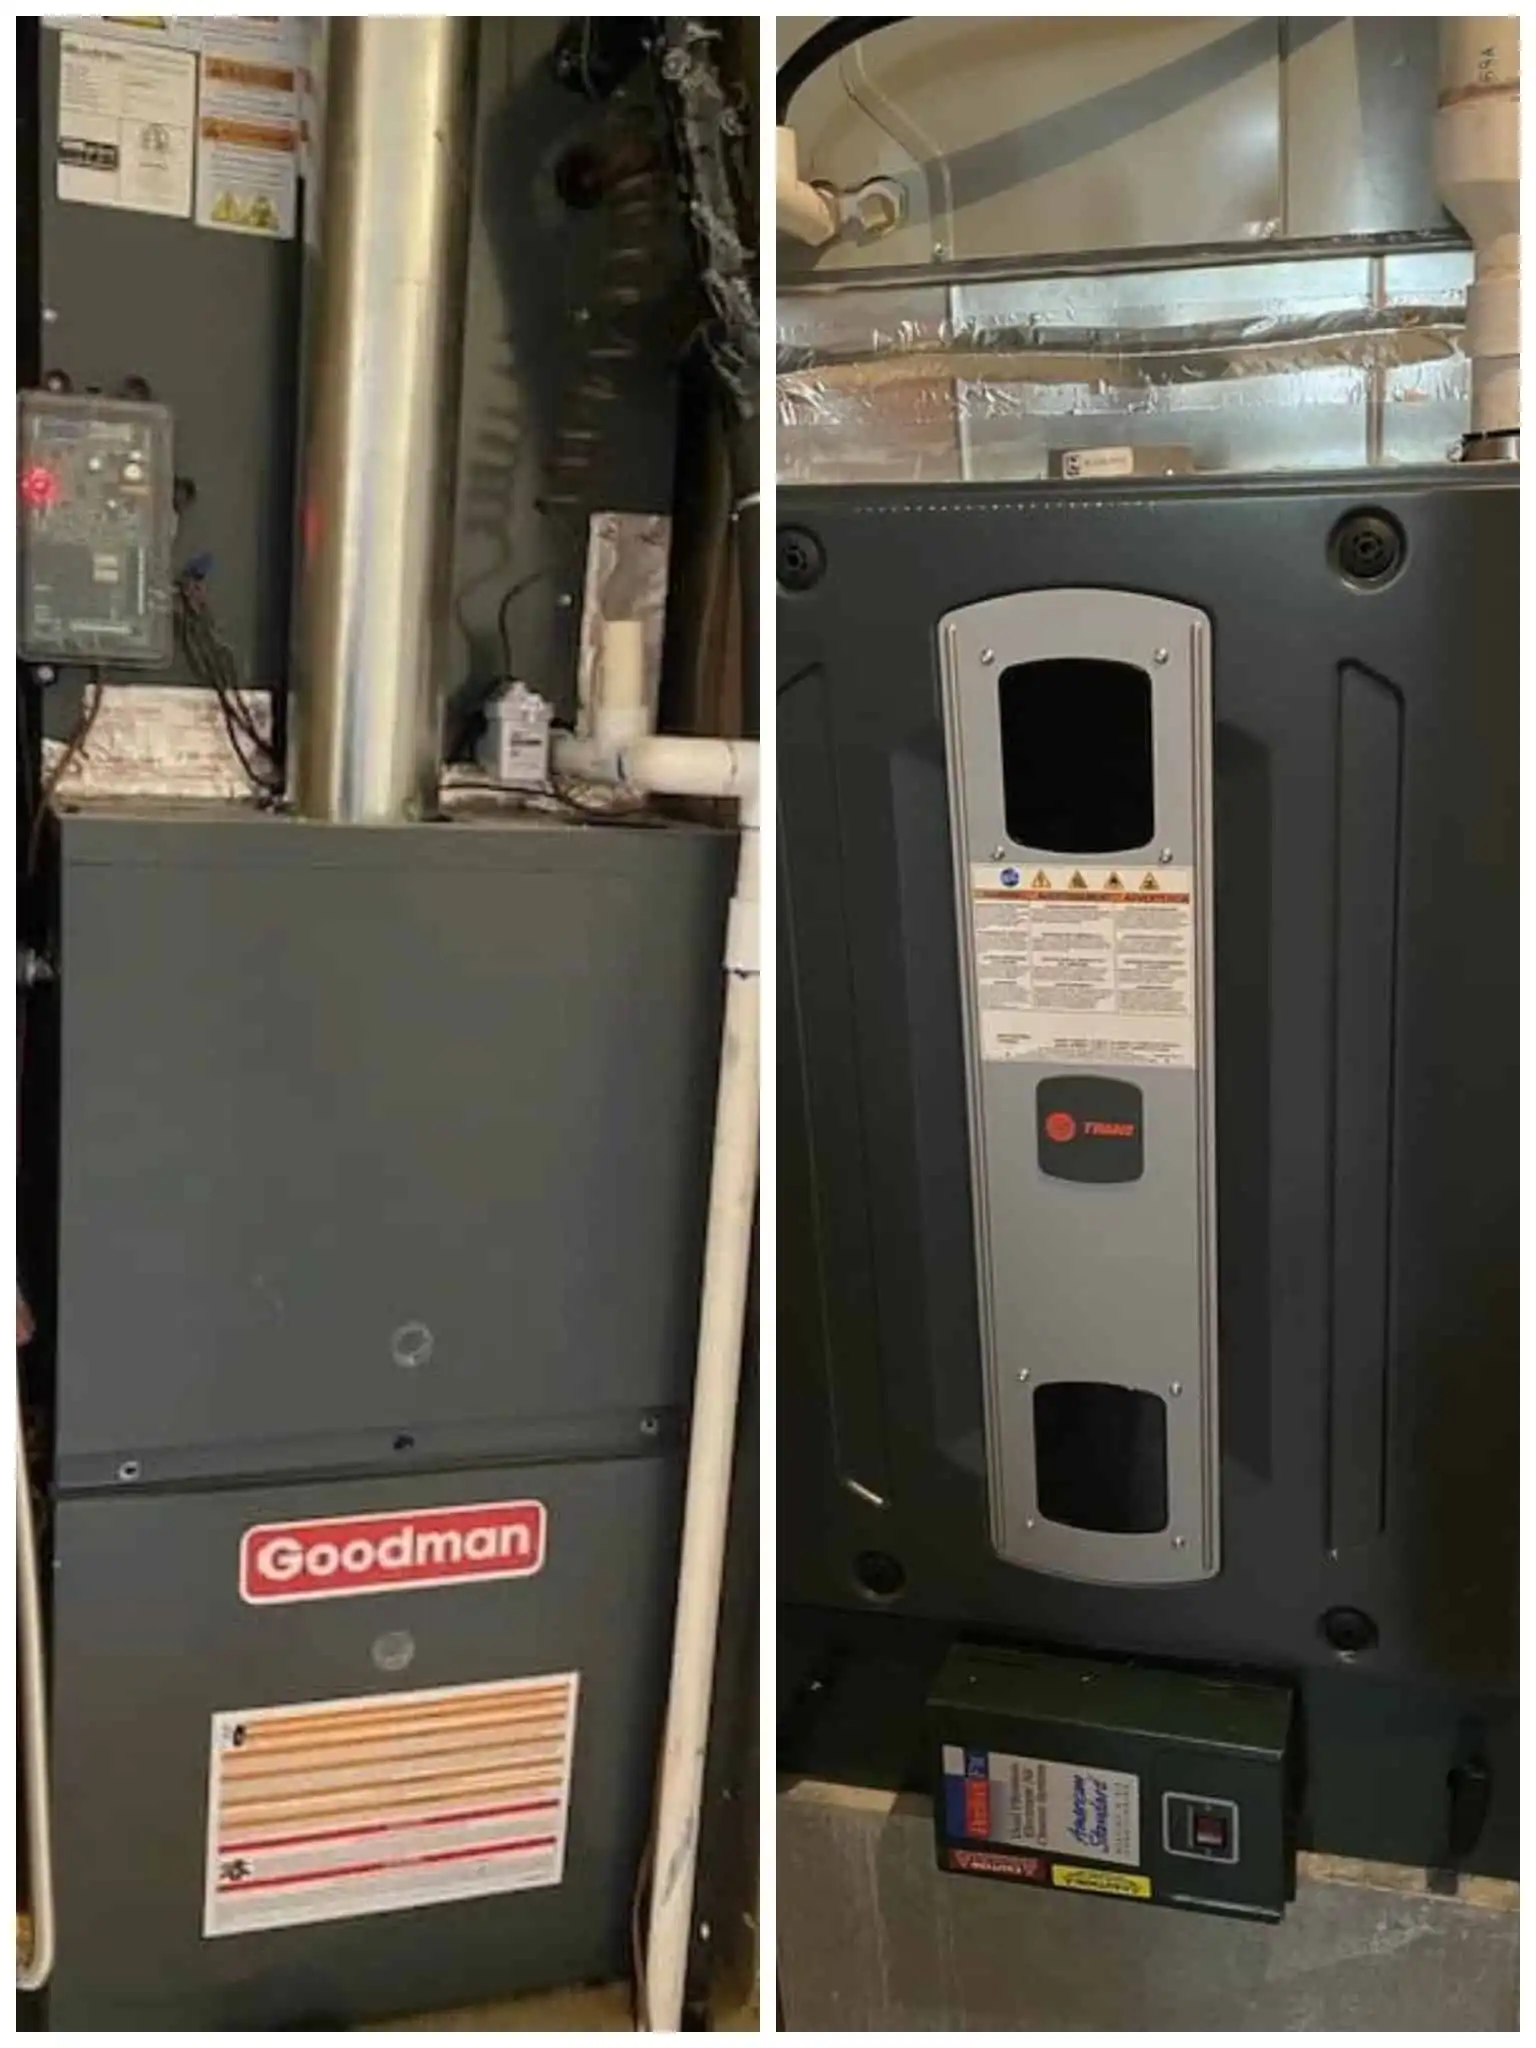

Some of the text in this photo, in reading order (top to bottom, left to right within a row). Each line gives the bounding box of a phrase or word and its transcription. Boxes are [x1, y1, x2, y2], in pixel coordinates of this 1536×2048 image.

[256, 1523, 530, 1581] Goodman
[1066, 1774, 1087, 1846] American
[1088, 1773, 1109, 1854] Standard
